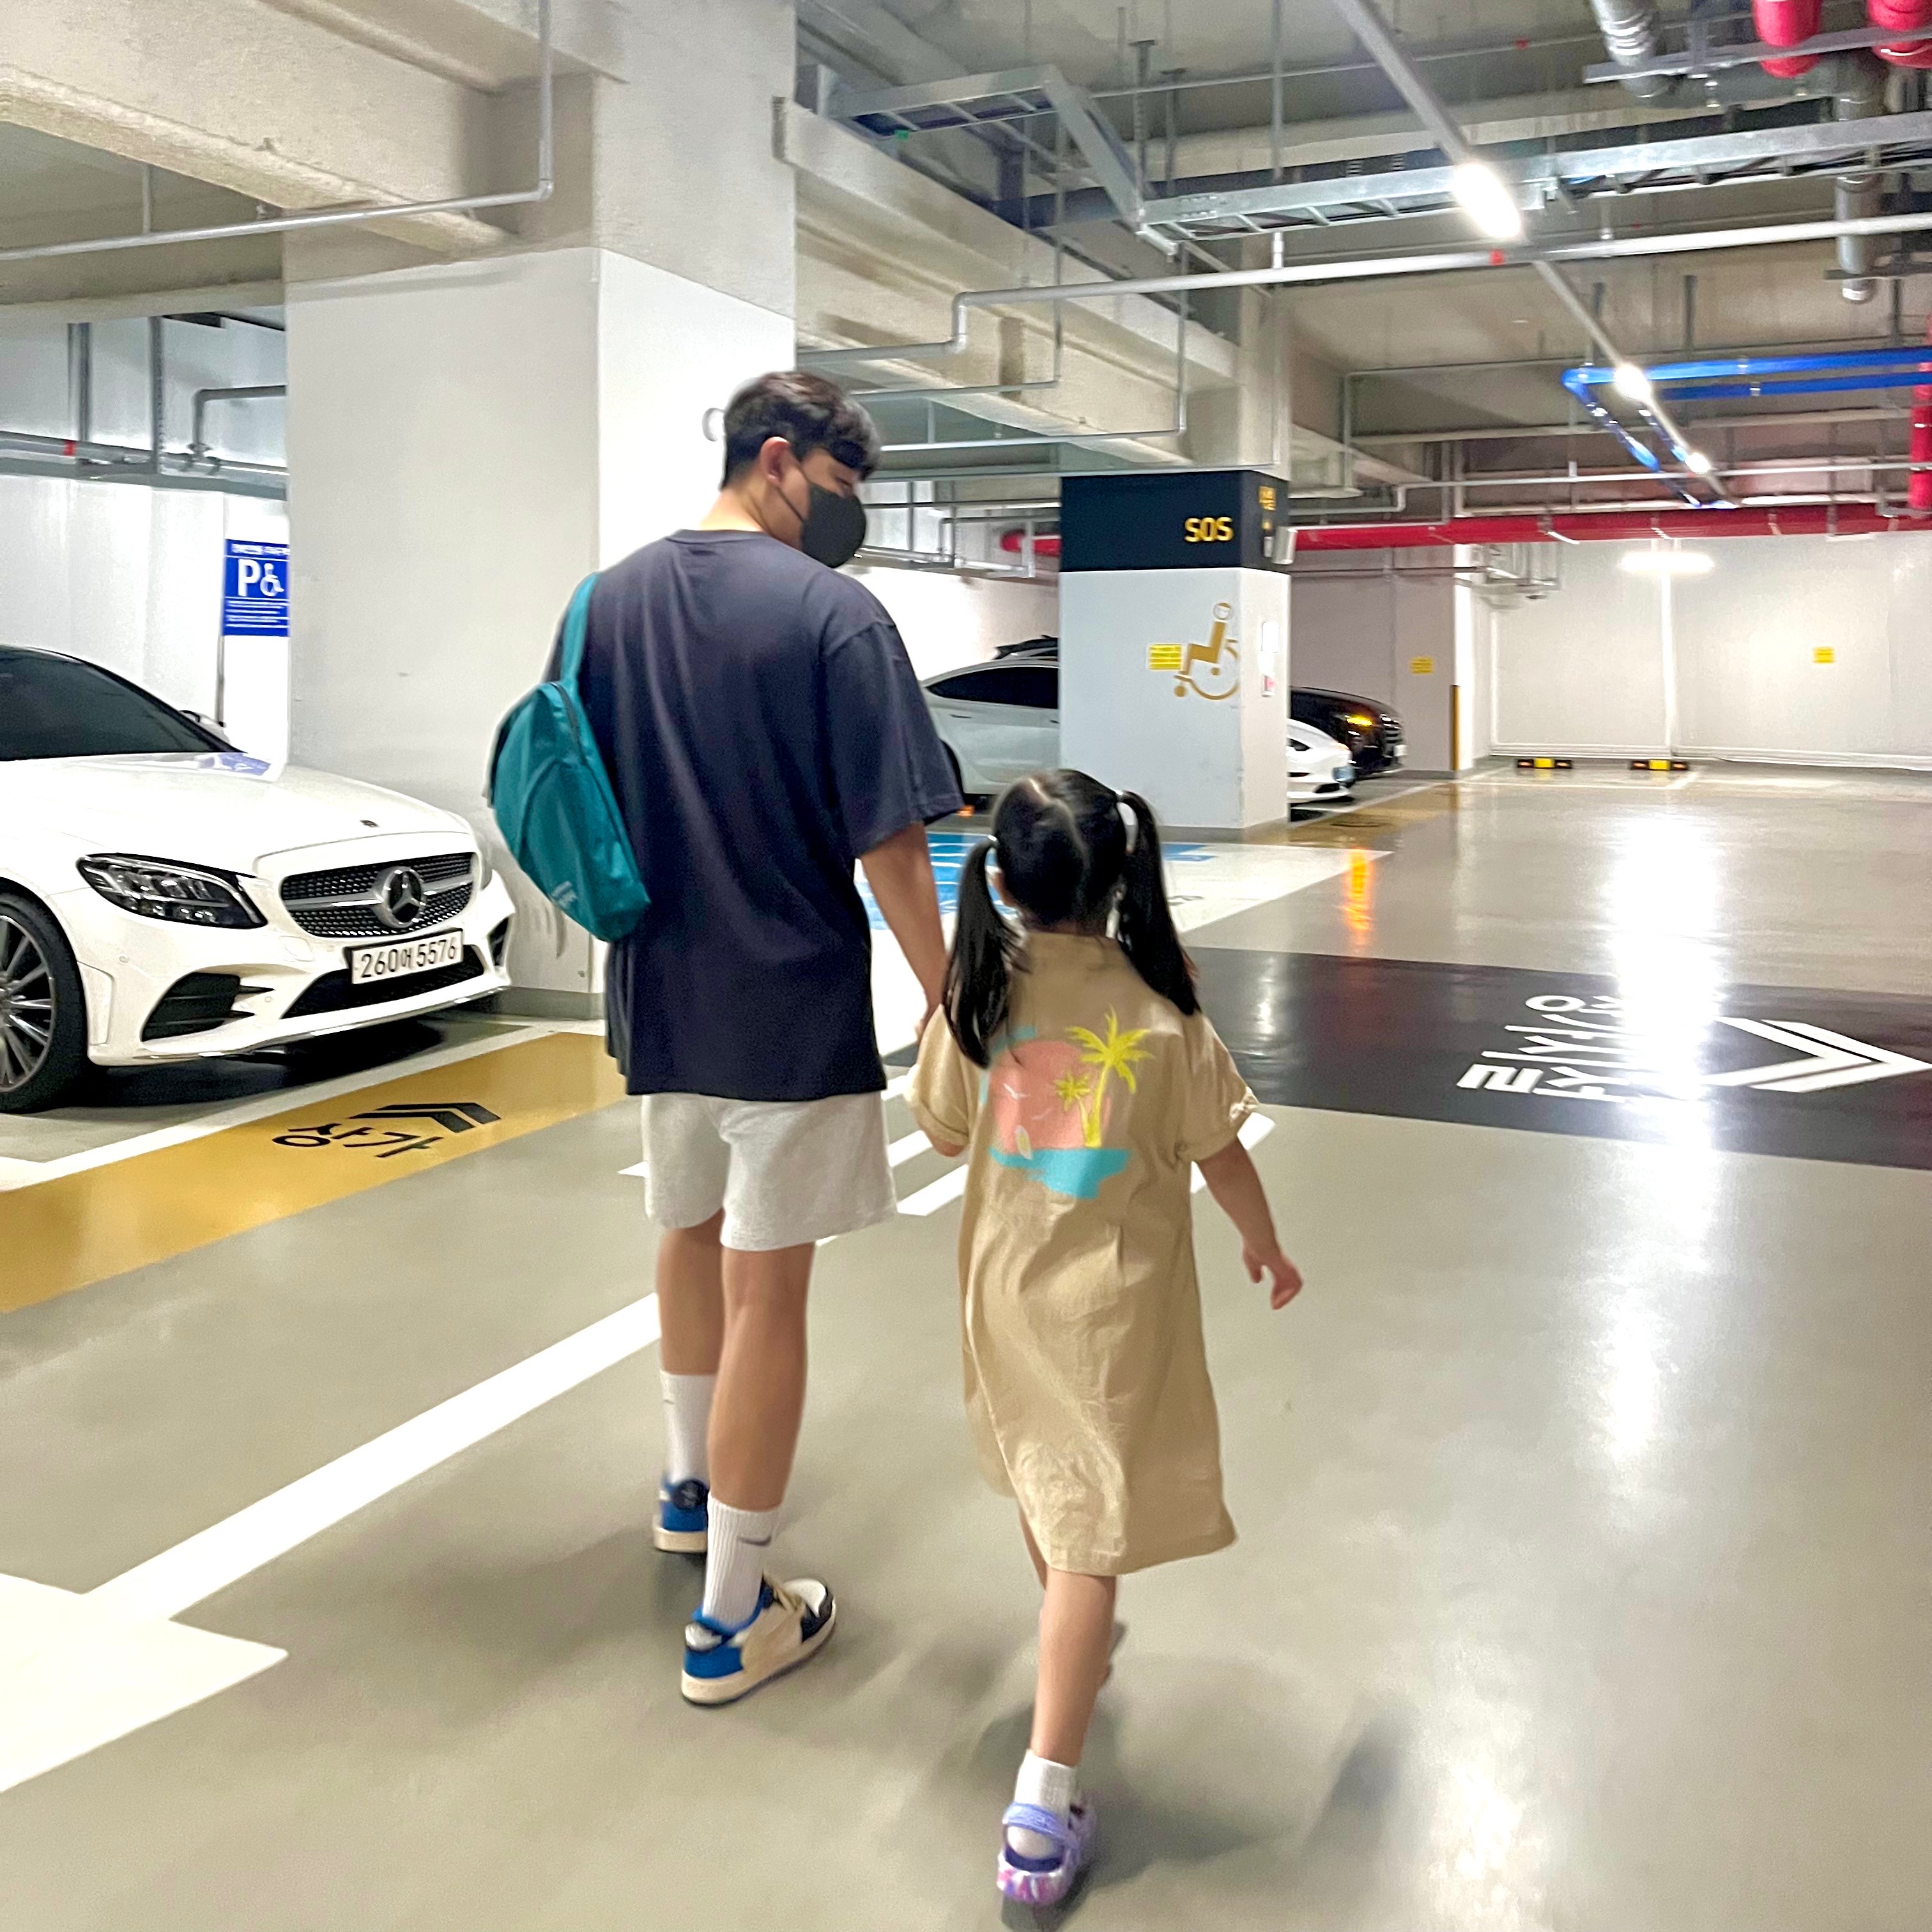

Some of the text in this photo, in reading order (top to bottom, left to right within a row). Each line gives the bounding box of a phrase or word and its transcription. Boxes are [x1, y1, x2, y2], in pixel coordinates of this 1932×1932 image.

[1184, 516, 1234, 542] SOS
[238, 558, 261, 597] P
[417, 937, 456, 967] 5576
